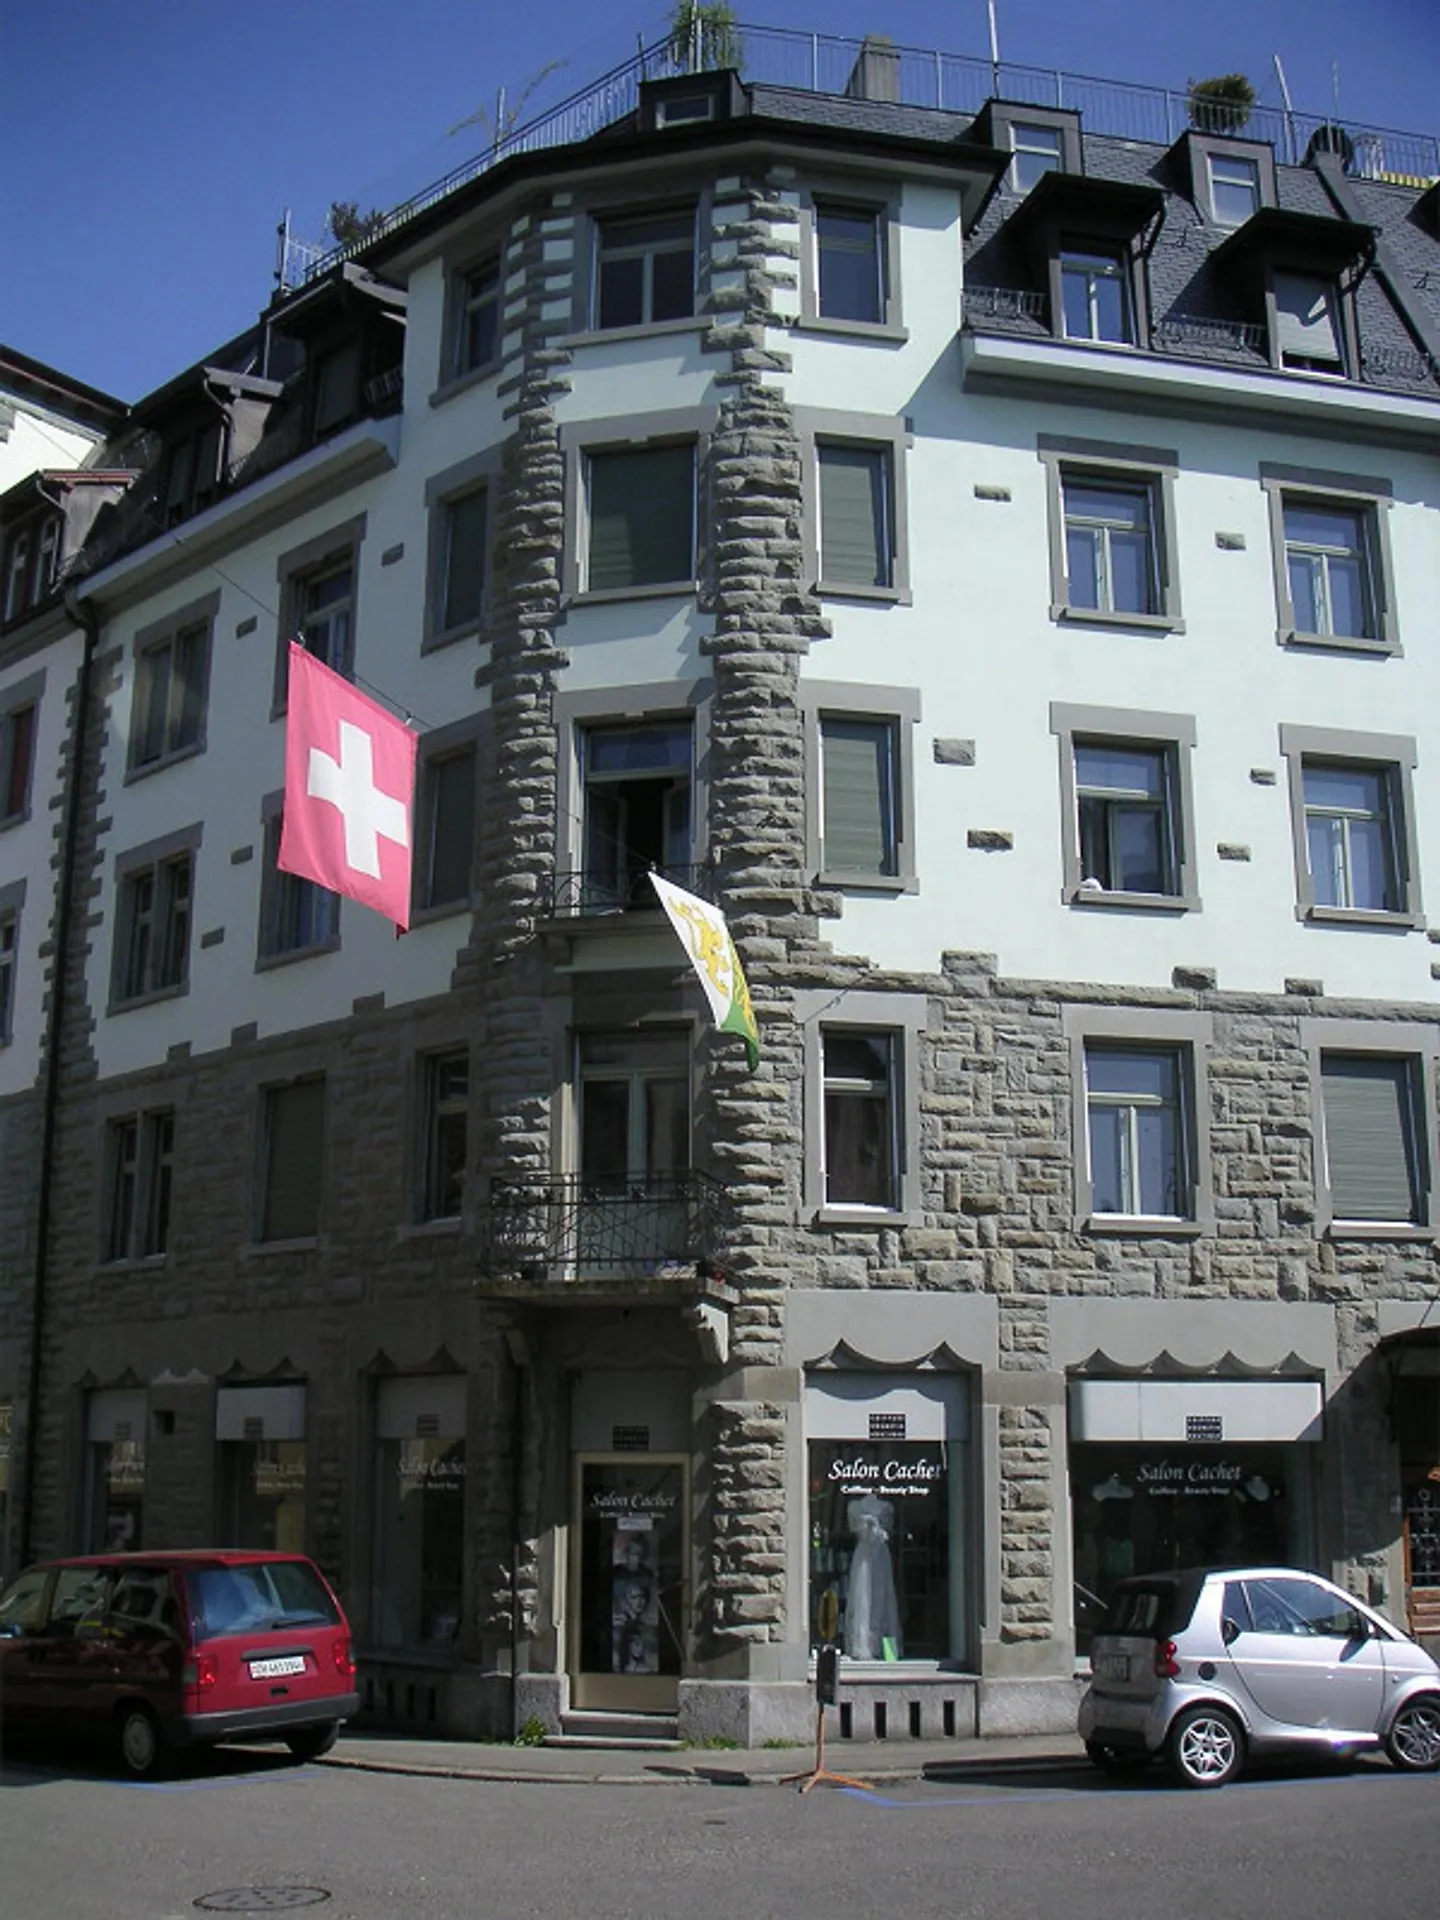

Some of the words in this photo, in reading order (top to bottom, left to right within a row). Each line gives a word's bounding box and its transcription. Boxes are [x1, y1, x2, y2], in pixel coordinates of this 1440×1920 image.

[828, 1457, 879, 1480] Salon
[1136, 1459, 1184, 1482] Salon
[1188, 1460, 1243, 1482] Cachet
[590, 1490, 628, 1508] Salon
